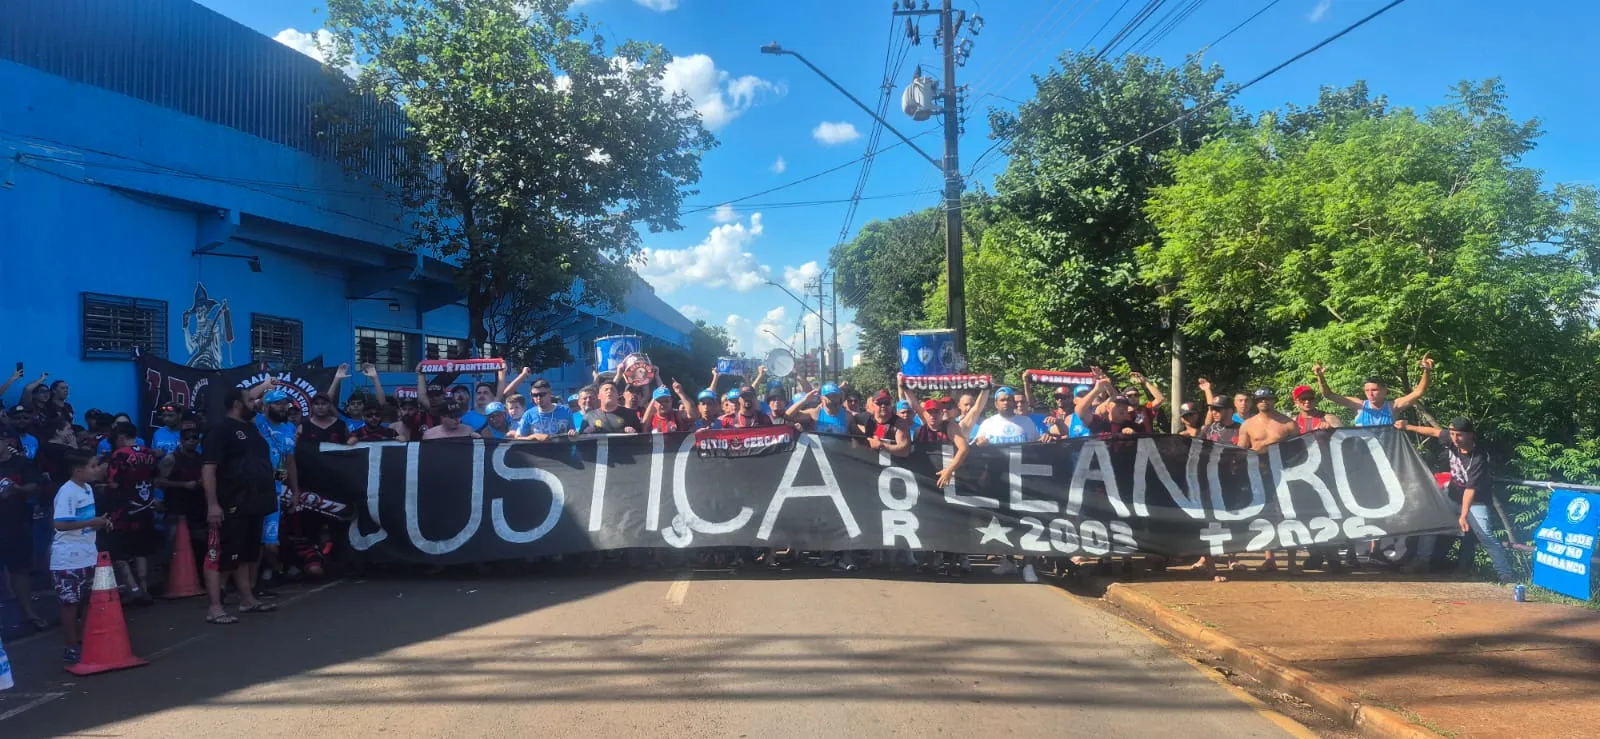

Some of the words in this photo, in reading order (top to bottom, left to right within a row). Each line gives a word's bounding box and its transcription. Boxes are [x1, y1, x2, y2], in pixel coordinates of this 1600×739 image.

[421, 365, 444, 373] ZONA
[454, 362, 502, 372] FRONTEIRA
[277, 372, 291, 382] JÁ
[905, 373, 990, 391] OURINHOS
[319, 431, 862, 555] JUSTIÇA
[942, 428, 1406, 521] LEANDRO
[1019, 516, 1139, 555] 2003
